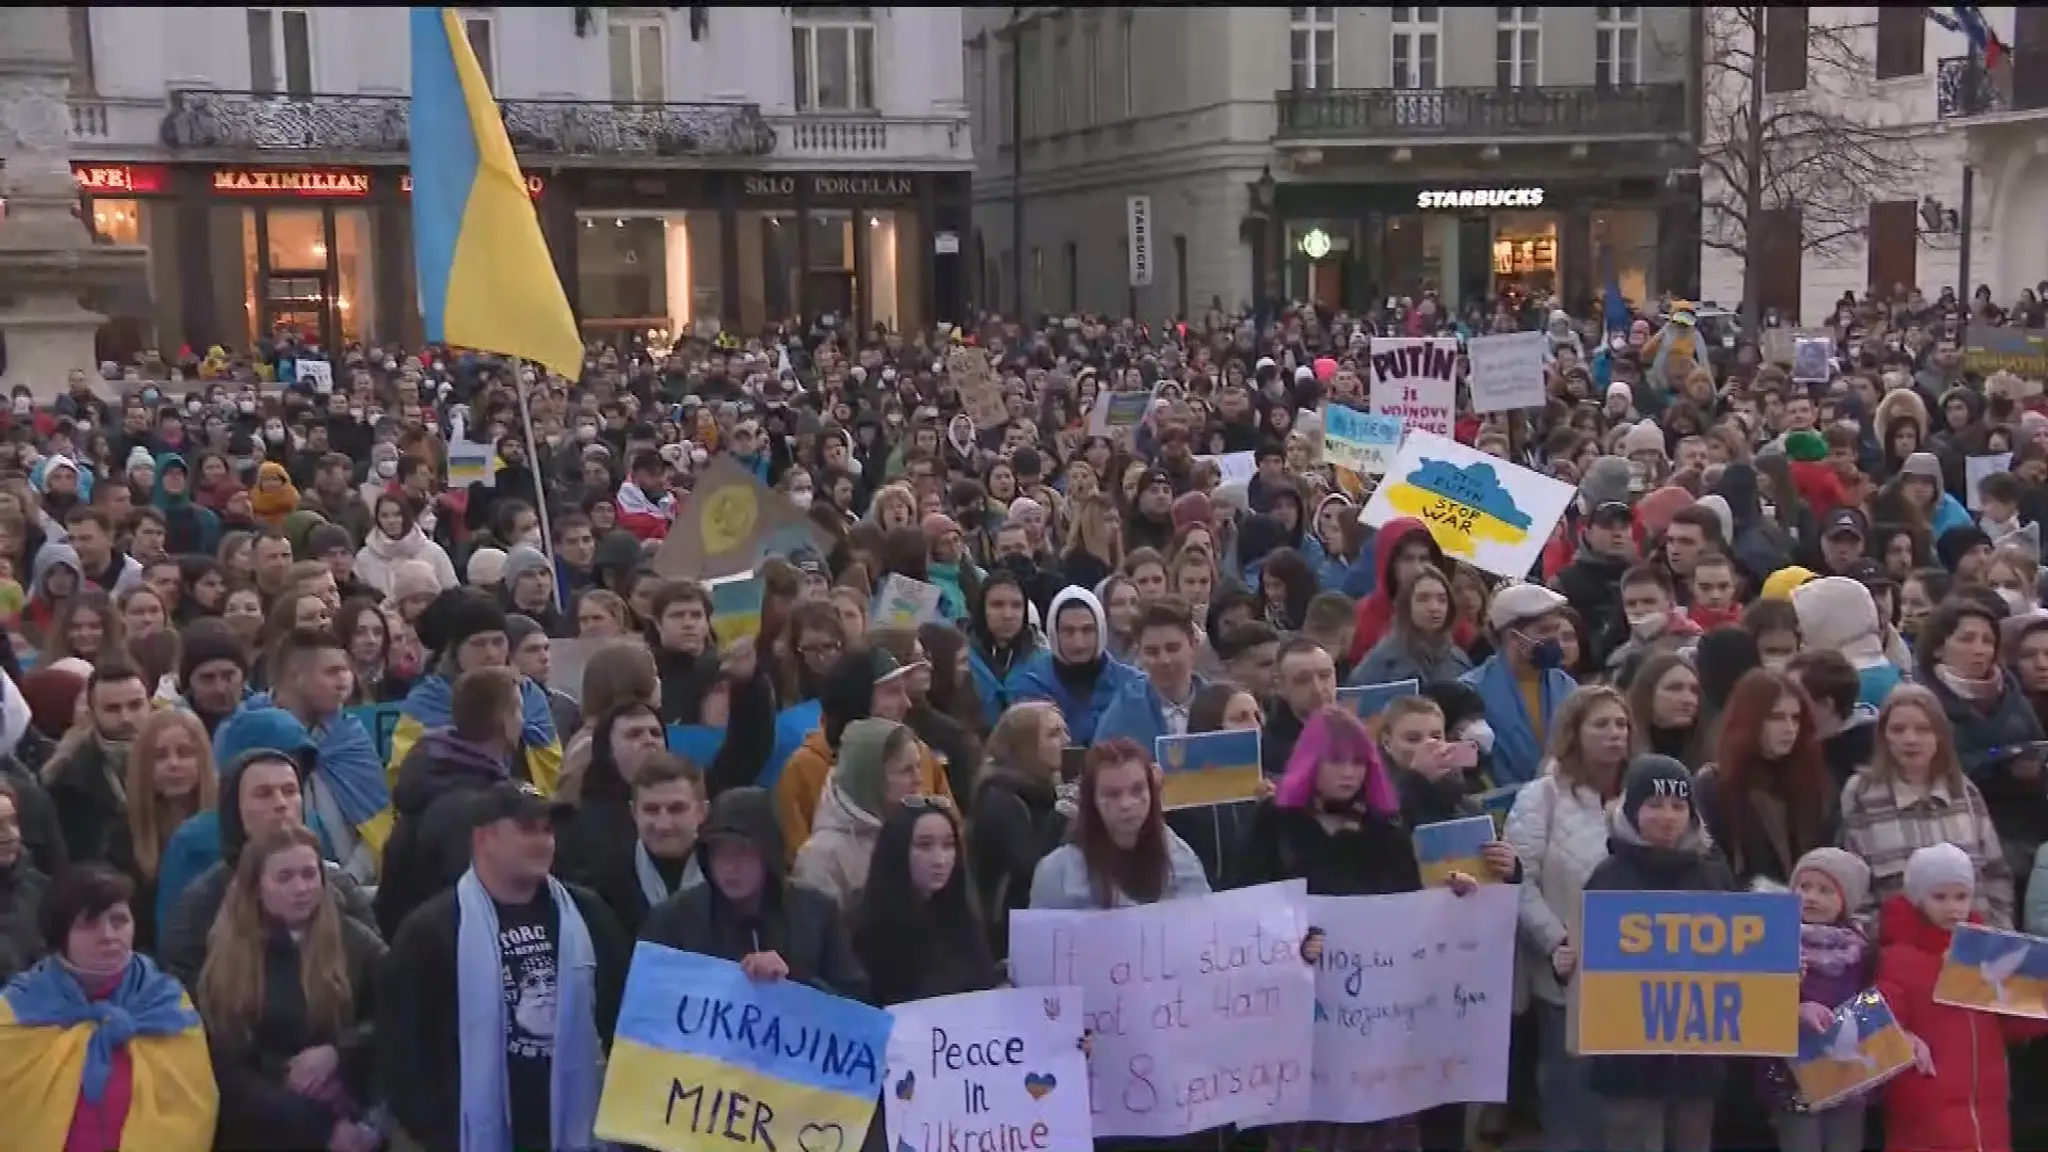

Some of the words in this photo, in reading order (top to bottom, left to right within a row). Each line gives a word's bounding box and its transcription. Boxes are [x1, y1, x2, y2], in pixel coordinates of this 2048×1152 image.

[213, 171, 369, 192] MAXIMILIAN
[745, 176, 795, 194] SKLO
[1416, 187, 1545, 208] STARBUCKS
[1422, 505, 1472, 535] WAR
[1434, 499, 1481, 520] STOP
[1653, 778, 1688, 798] NYC
[1110, 922, 1177, 986] all
[1618, 911, 1766, 956] STOP
[1152, 985, 1190, 1029] at
[1639, 980, 1743, 1043] WAR
[676, 994, 877, 1083] UKRAJINA
[931, 1025, 1025, 1078] Peace
[1122, 1053, 1157, 1114] 8
[665, 1077, 777, 1151] MIER
[922, 1120, 1050, 1151] Ukraine
